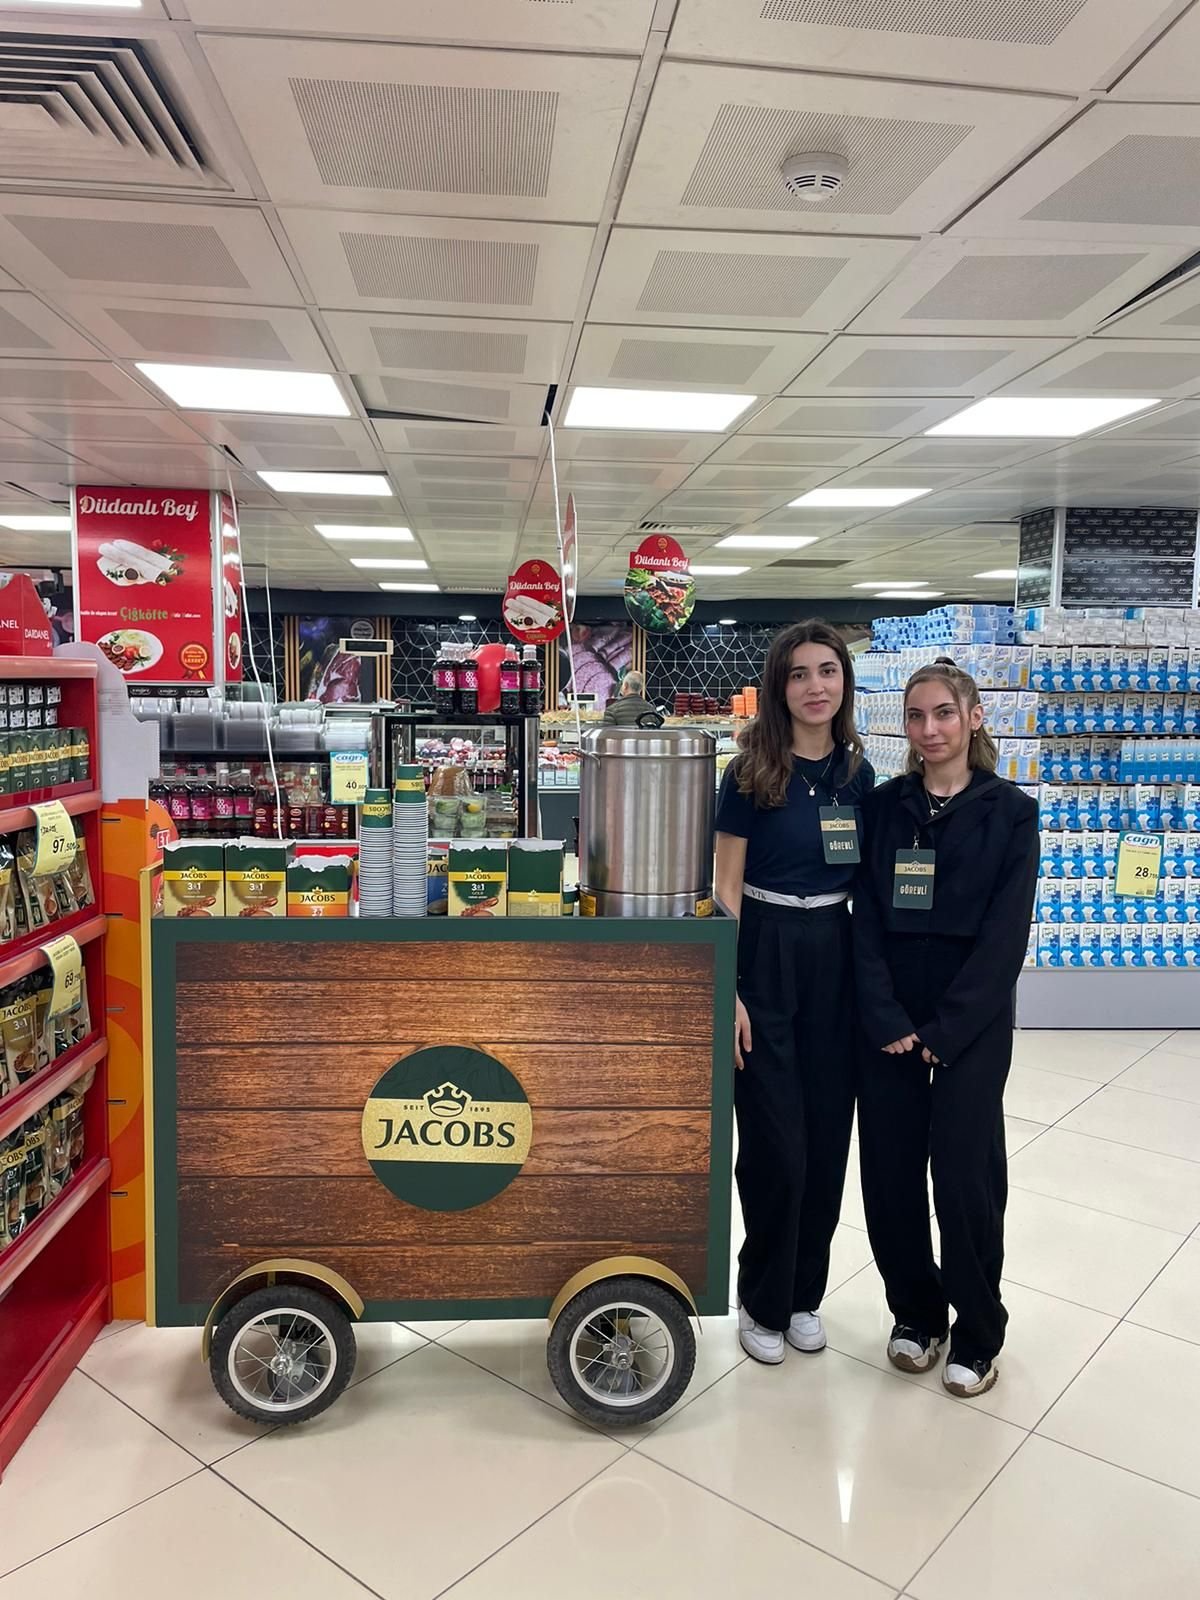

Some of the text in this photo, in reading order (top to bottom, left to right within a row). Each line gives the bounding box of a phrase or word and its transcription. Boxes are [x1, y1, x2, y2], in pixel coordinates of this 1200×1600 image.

[80, 496, 199, 521] Düdanlı Bey
[634, 555, 689, 570] Düdanlı Bey
[509, 580, 560, 593] Düdanlı Bey
[120, 606, 168, 622] Çiğköfte
[346, 780, 357, 789] 40
[52, 838, 65, 853] 97
[242, 872, 270, 880] JACOBS
[1135, 866, 1149, 878] 28
[300, 894, 336, 903] JACOBS
[64, 972, 74, 989] 69
[374, 1118, 516, 1149] JACOBS
